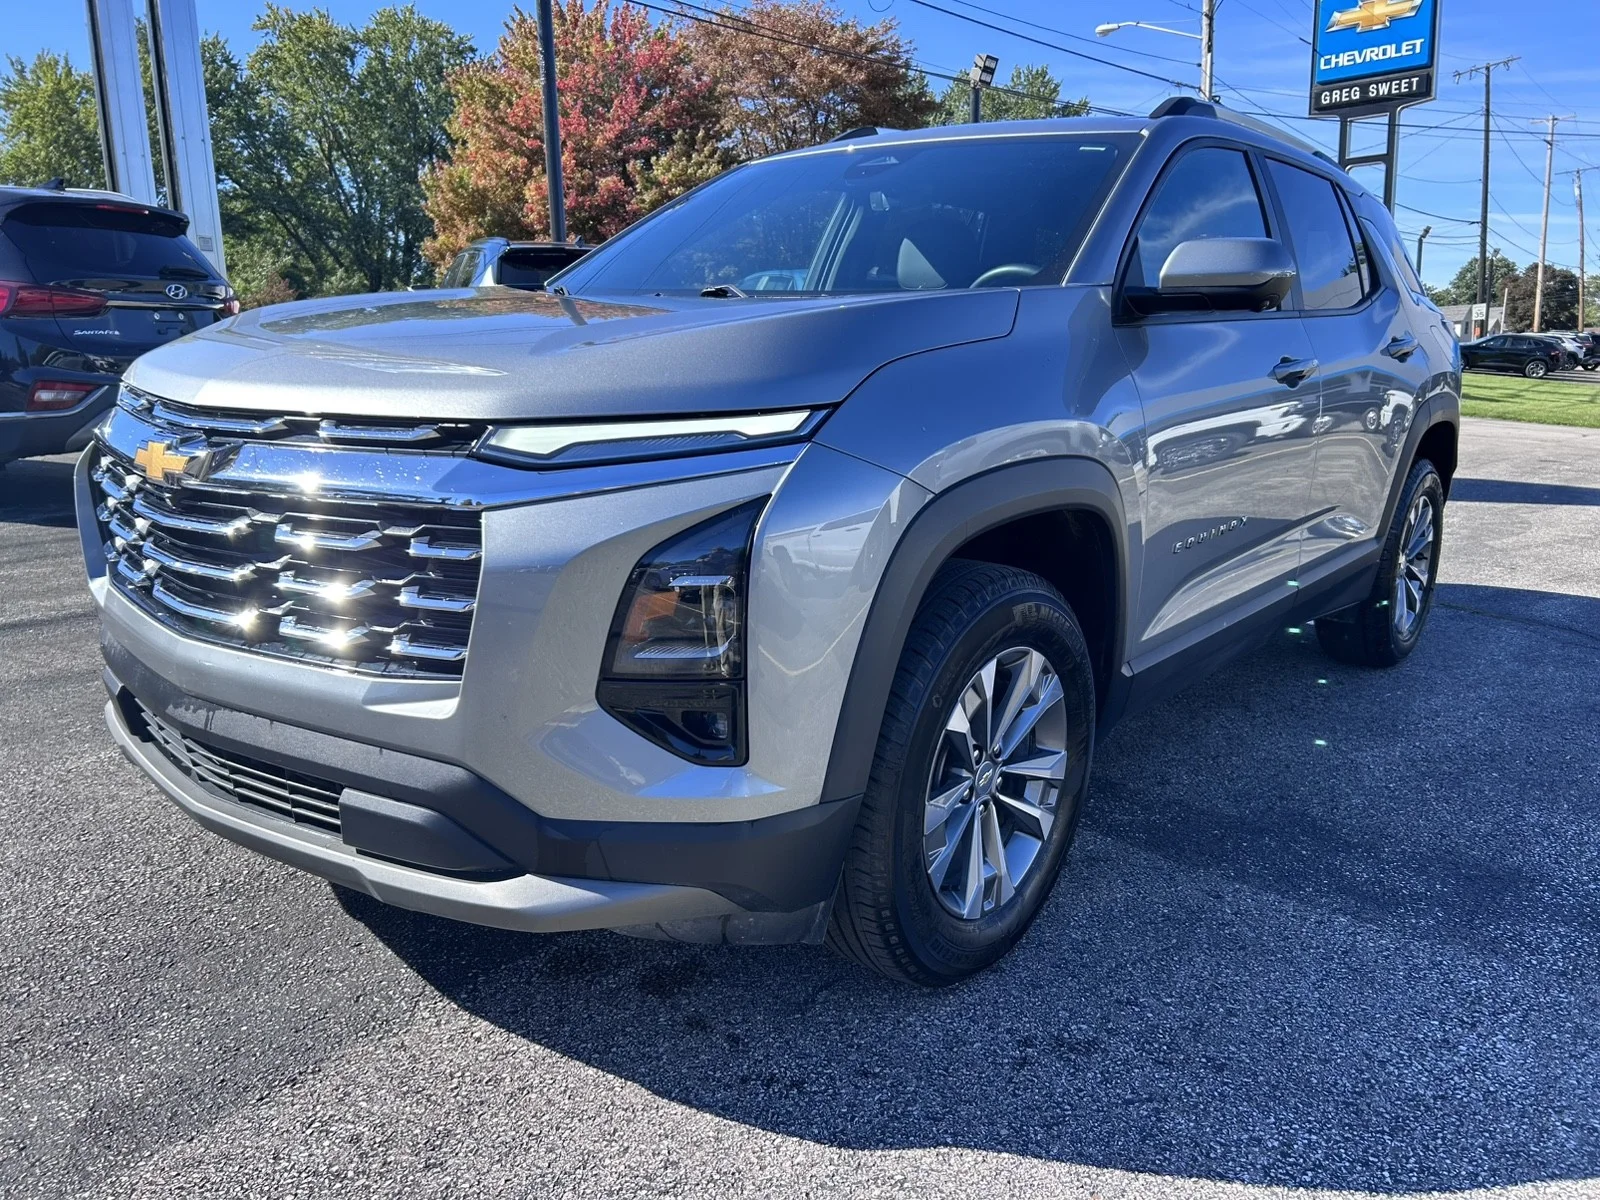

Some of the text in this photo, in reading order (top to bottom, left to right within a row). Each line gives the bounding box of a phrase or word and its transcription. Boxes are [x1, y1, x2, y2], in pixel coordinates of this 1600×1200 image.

[1320, 39, 1424, 70] CHEVROLET
[1321, 77, 1419, 105] GREG SWEET
[1172, 515, 1248, 554] EQUINOX
